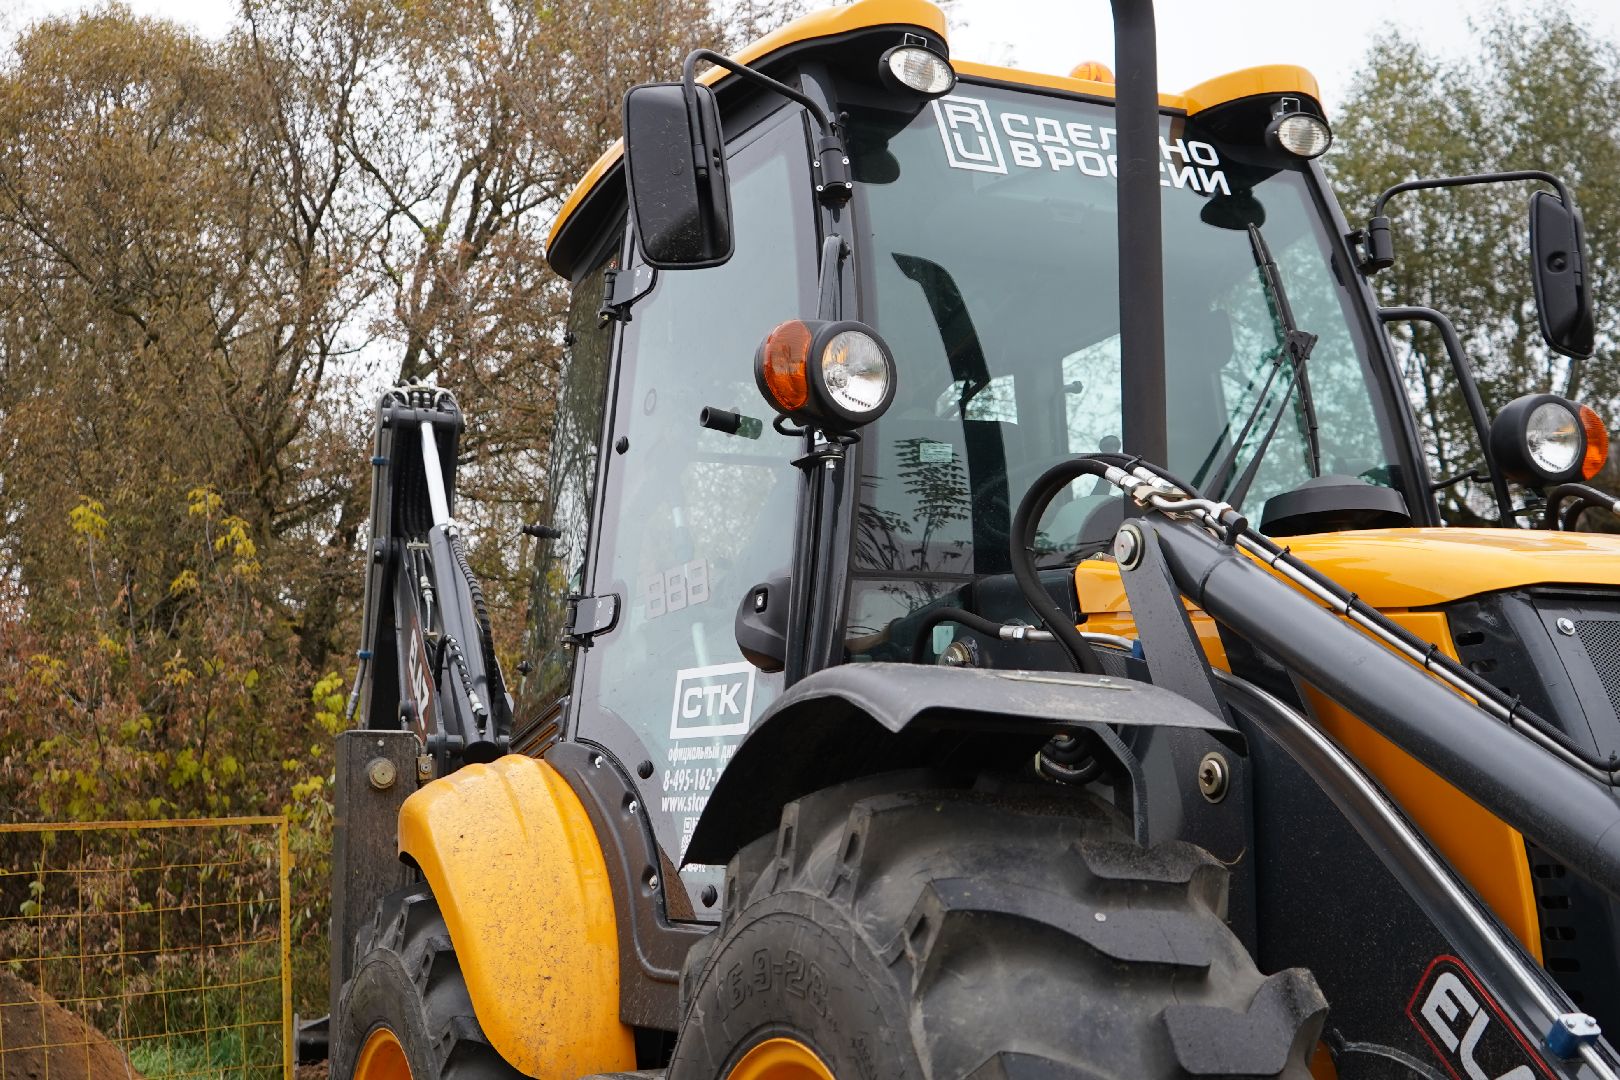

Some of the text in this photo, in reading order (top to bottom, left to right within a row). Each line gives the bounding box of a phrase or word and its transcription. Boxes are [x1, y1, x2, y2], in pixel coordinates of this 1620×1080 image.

[999, 112, 1220, 167] СДЕЛНО
[1042, 145, 1231, 196] РОИИ
[682, 682, 743, 719] СТК
[667, 741, 721, 767] официальный
[1421, 972, 1536, 1080] EL
